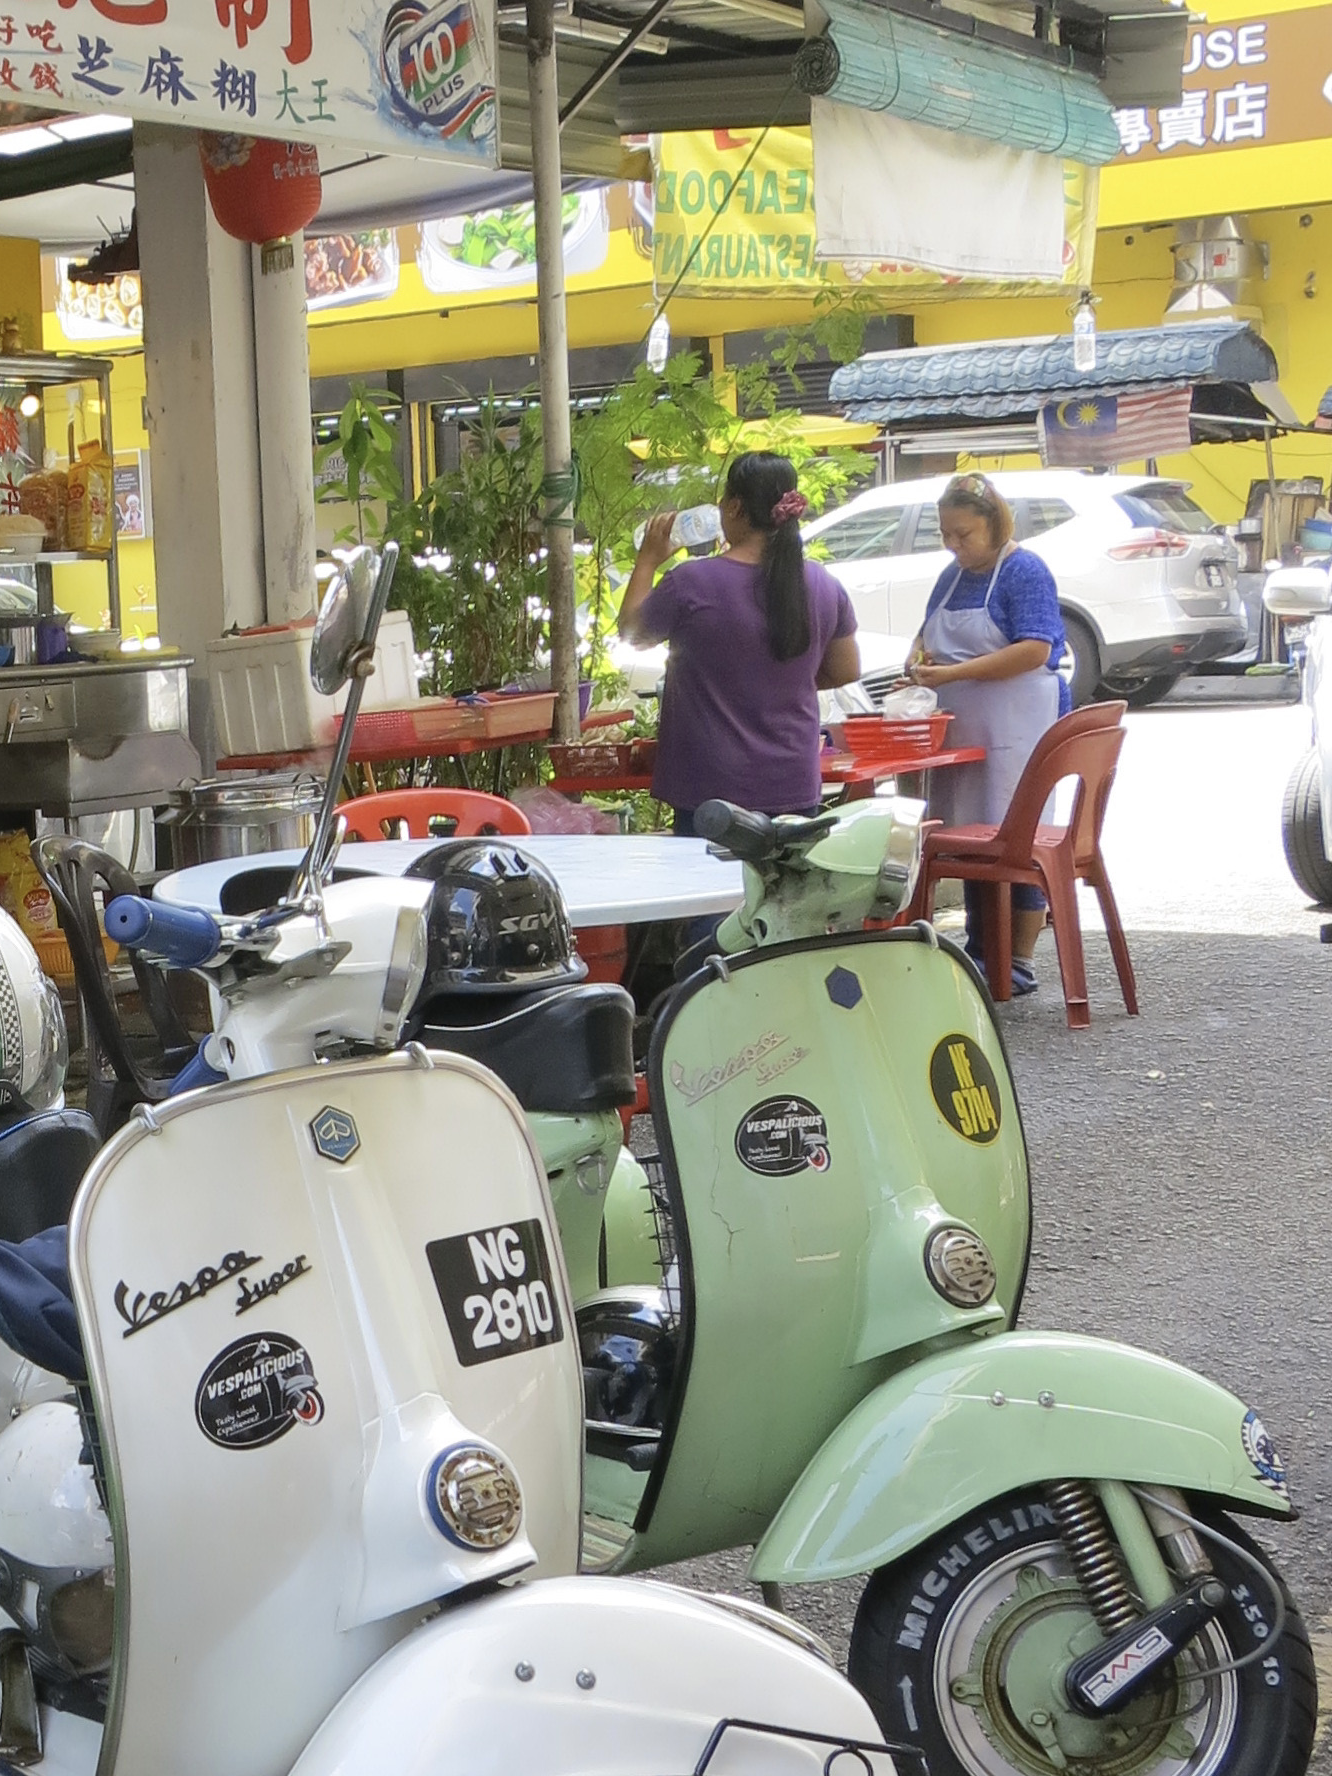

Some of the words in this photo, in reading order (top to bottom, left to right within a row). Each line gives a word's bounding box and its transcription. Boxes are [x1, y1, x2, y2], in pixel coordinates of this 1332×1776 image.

[72, 34, 257, 117] 芝麻糊
[275, 68, 337, 124] 大王
[409, 22, 457, 94] 100
[422, 74, 466, 114] PLUS
[746, 1115, 823, 1133] VESPALICIOUS
[951, 1085, 998, 1136] 9704
[467, 1227, 526, 1285] NG
[114, 1251, 263, 1339] Vespa
[236, 1254, 312, 1317] Super
[463, 1280, 554, 1349] 2810
[207, 1347, 305, 1400] VESPALICIOUS
[238, 1382, 262, 1402] .COM
[896, 1503, 1058, 1651] MICHELIN
[1084, 1629, 1163, 1699] RMS
